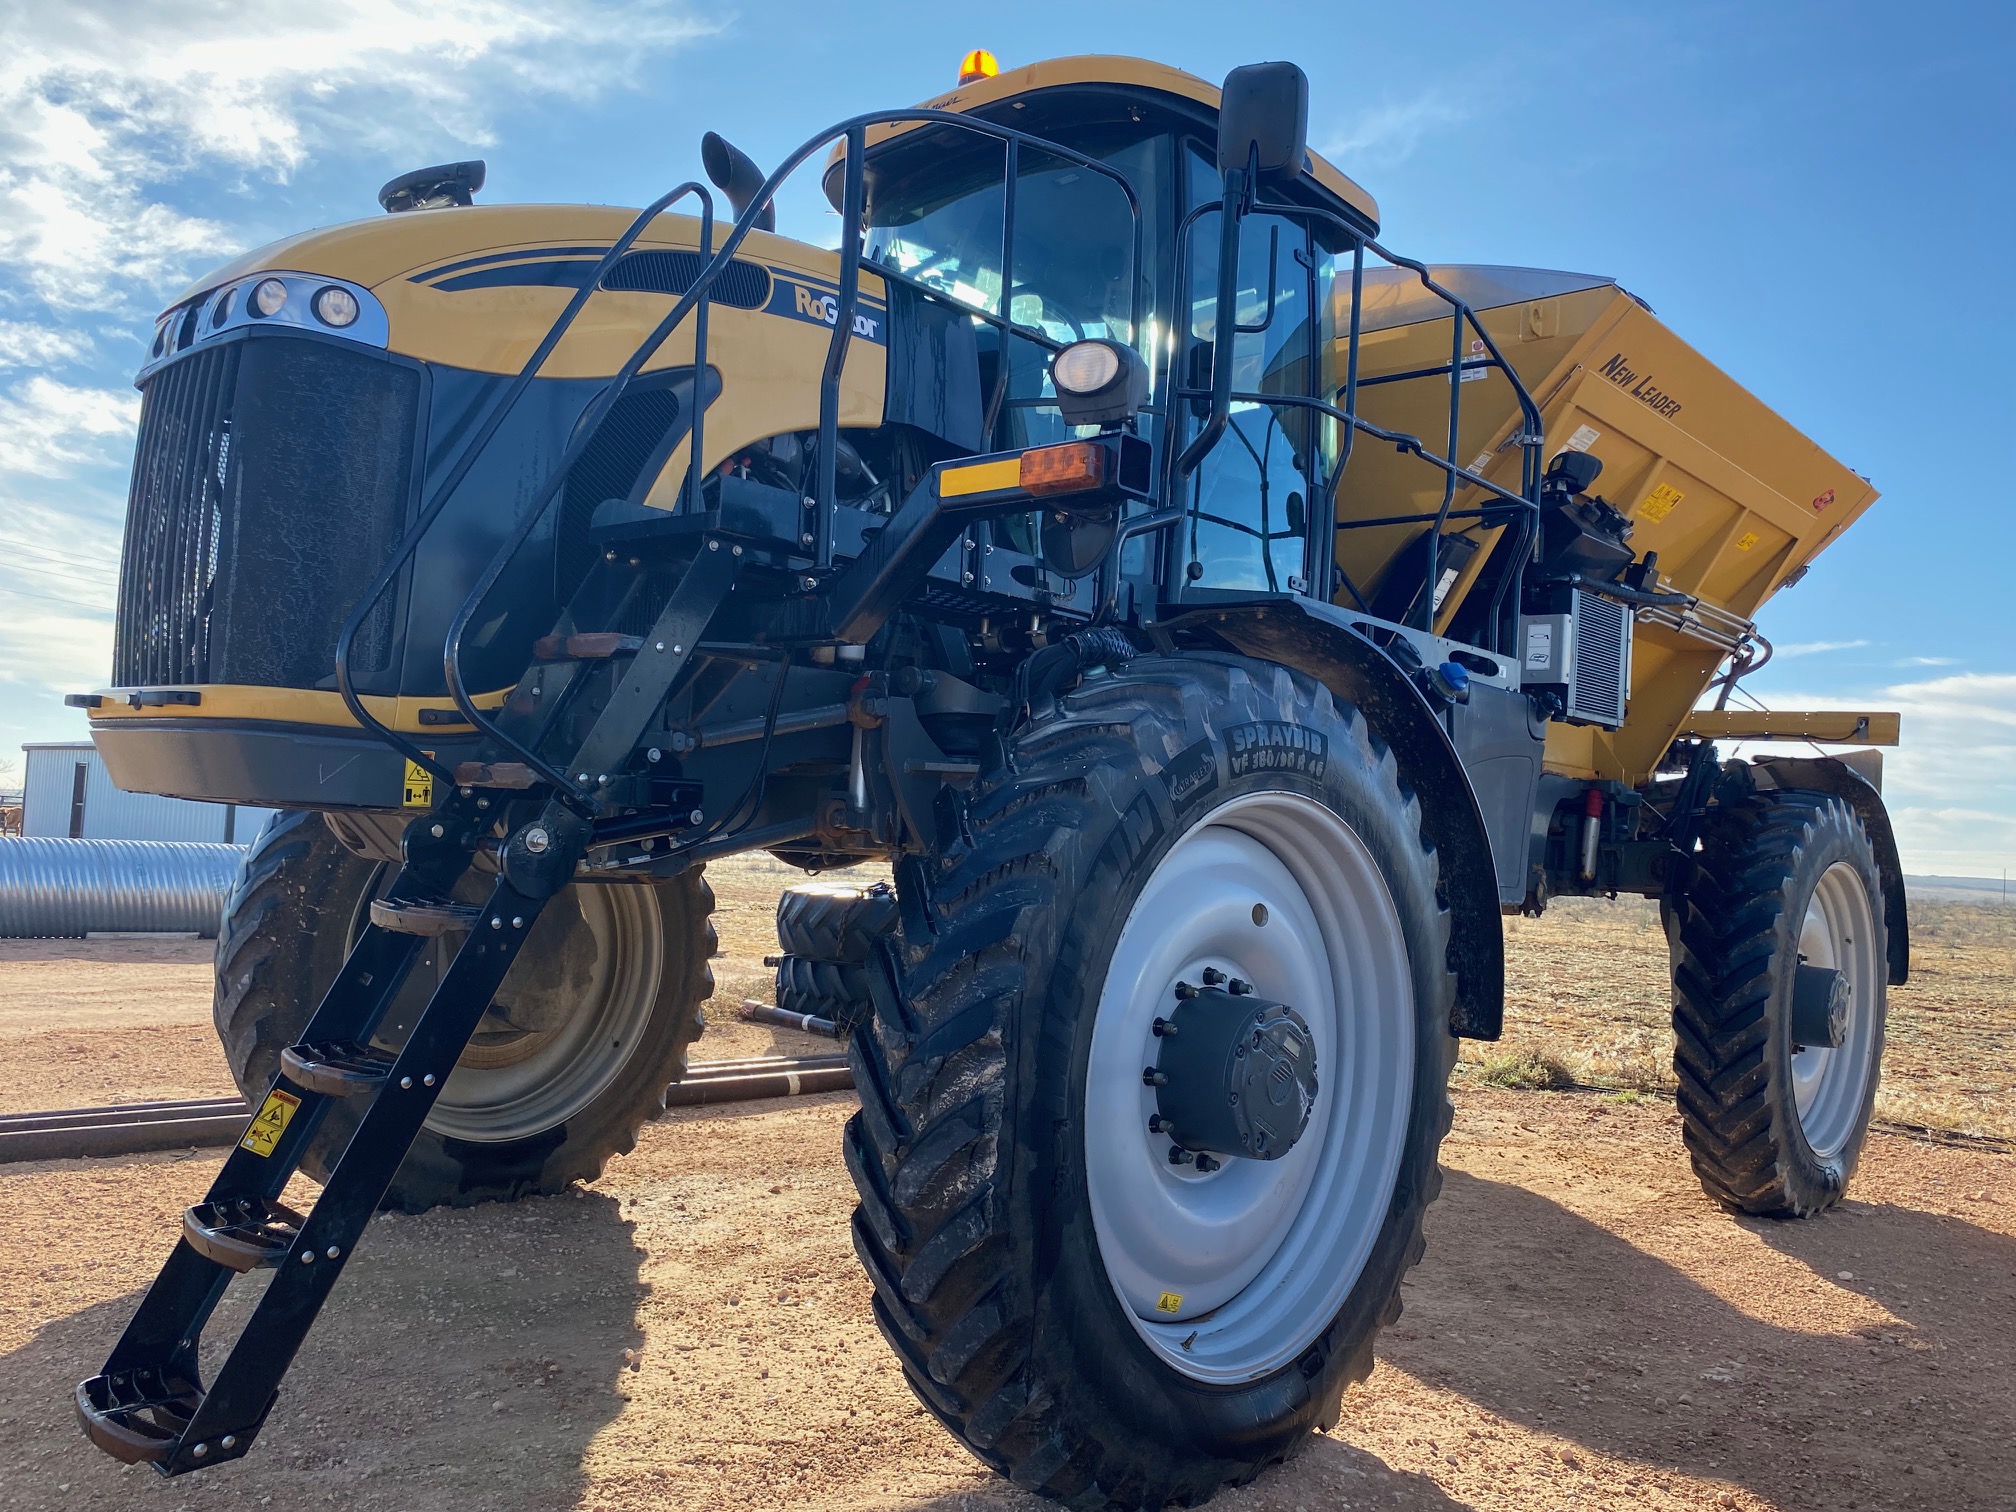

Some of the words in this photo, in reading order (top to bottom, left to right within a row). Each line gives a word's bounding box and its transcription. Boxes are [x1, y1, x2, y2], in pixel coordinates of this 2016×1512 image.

[794, 285, 878, 338] RoGor
[1231, 753, 1249, 774] VF
[1297, 753, 1306, 771] R
